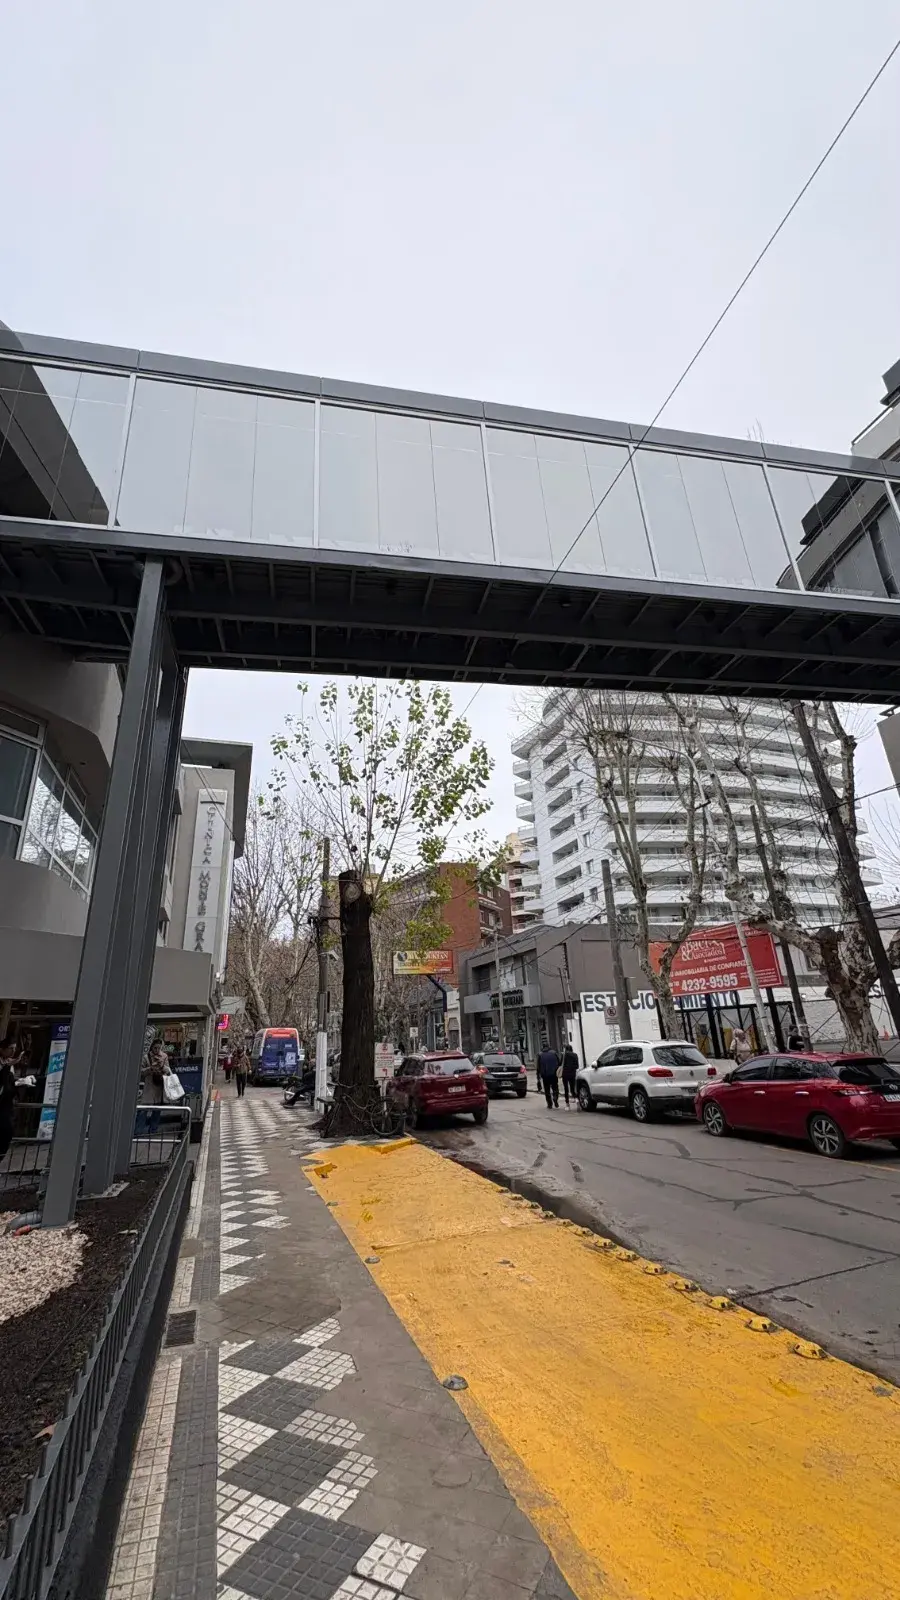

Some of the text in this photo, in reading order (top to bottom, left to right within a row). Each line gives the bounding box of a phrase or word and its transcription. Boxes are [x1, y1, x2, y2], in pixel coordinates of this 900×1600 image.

[709, 964, 717, 972] DE
[717, 959, 748, 971] CONFIANZ
[681, 972, 739, 992] 4232-9595
